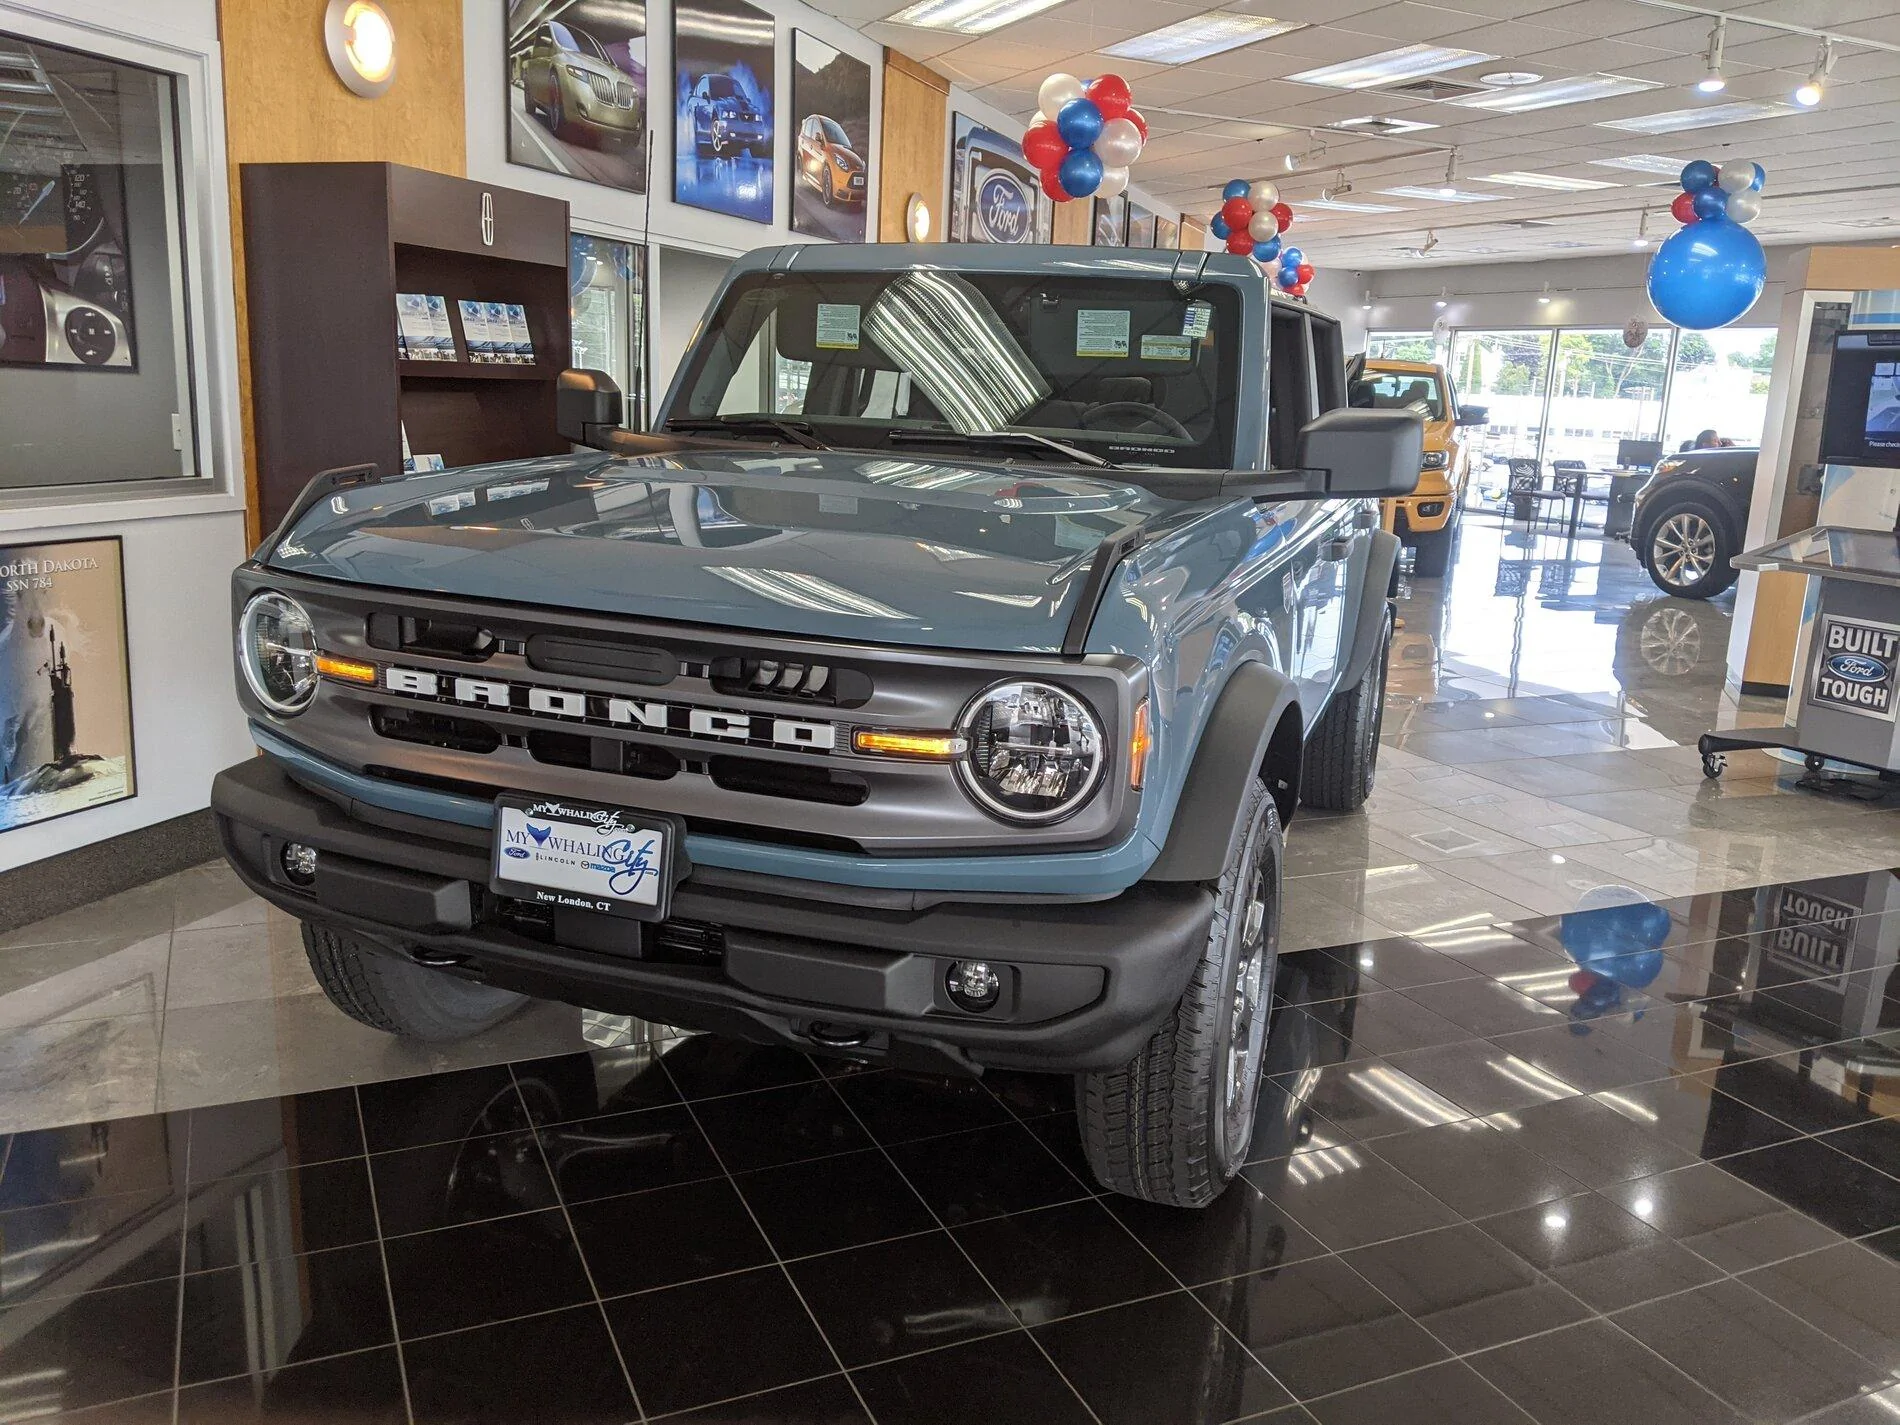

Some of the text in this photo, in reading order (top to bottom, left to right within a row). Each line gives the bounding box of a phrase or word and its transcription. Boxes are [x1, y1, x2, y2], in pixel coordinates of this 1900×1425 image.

[988, 183, 1020, 236] Ford
[1108, 445, 1175, 453] BRONCO
[6, 577, 53, 592] SSN 784
[1828, 624, 1899, 658] BUILT
[1839, 658, 1876, 677] Ford
[1821, 677, 1889, 708] TOUGH
[385, 667, 836, 750] BRONCO
[532, 803, 547, 813] MY
[590, 809, 623, 836] City
[506, 829, 659, 896] MY WHALING City
[507, 848, 527, 860] Ford
[540, 854, 576, 866] LINCOLN
[590, 862, 616, 874] mazda
[536, 891, 611, 912] New London, CT
